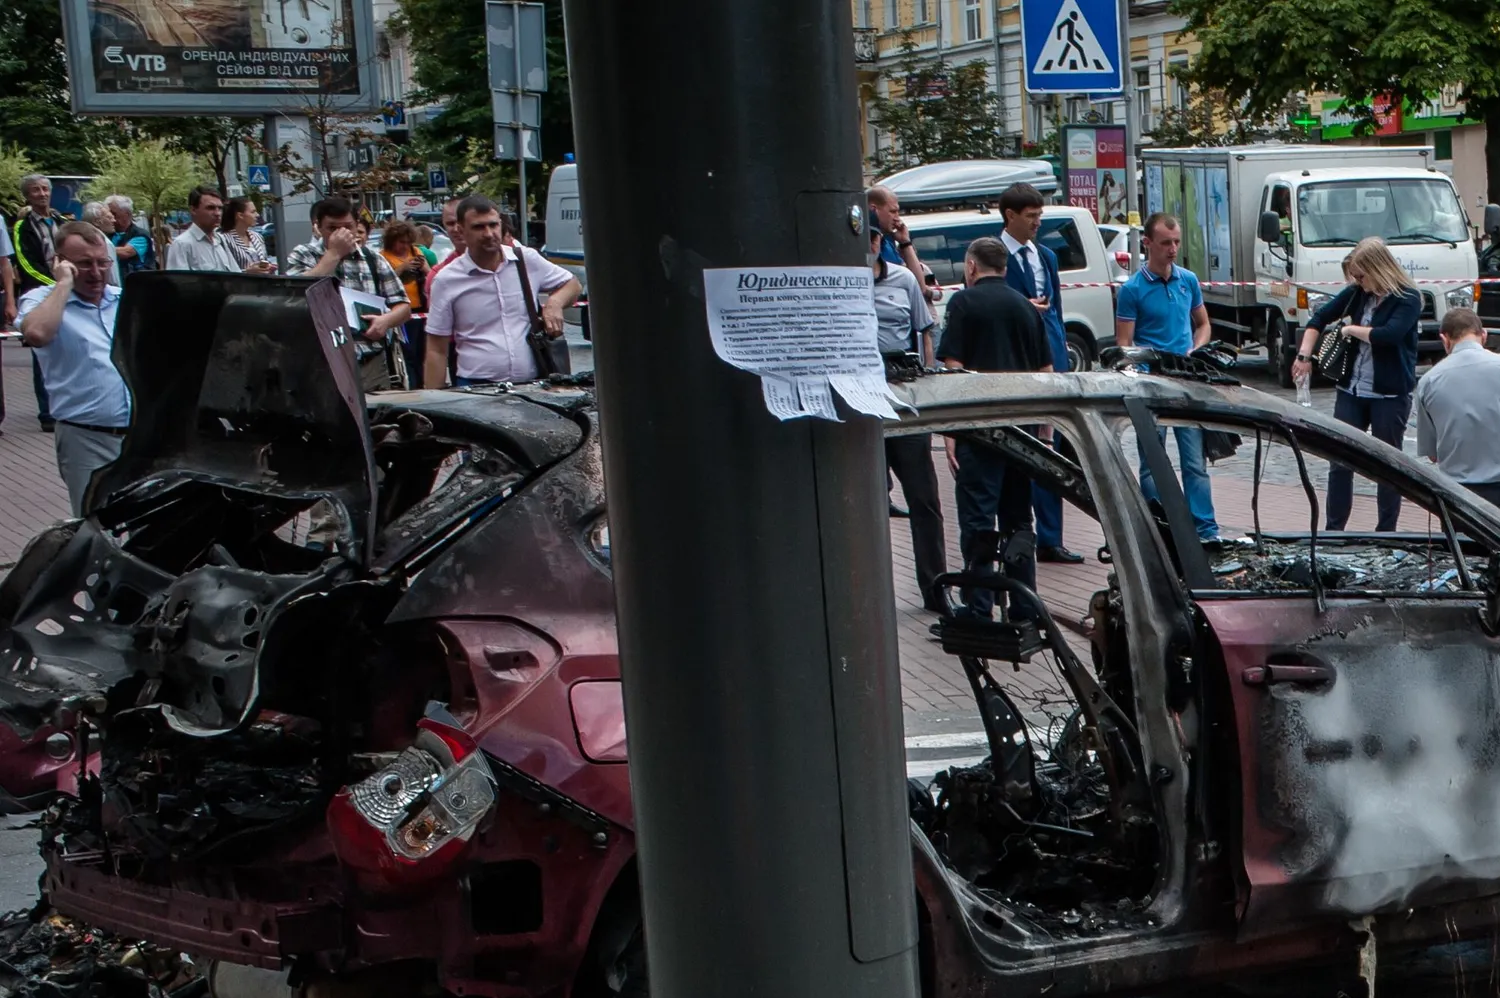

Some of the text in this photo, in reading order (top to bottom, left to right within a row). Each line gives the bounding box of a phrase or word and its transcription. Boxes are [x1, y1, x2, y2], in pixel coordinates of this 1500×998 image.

[182, 50, 235, 61] ОРЕНДА
[126, 54, 167, 71] VTB
[216, 65, 319, 78] СЕЙФІВ ВІД VTB
[1069, 175, 1096, 187] TOTAL
[1070, 187, 1096, 196] SUMMER
[1070, 196, 1097, 210] SALE
[737, 273, 842, 291] Юридические
[740, 294, 774, 304] Первая
